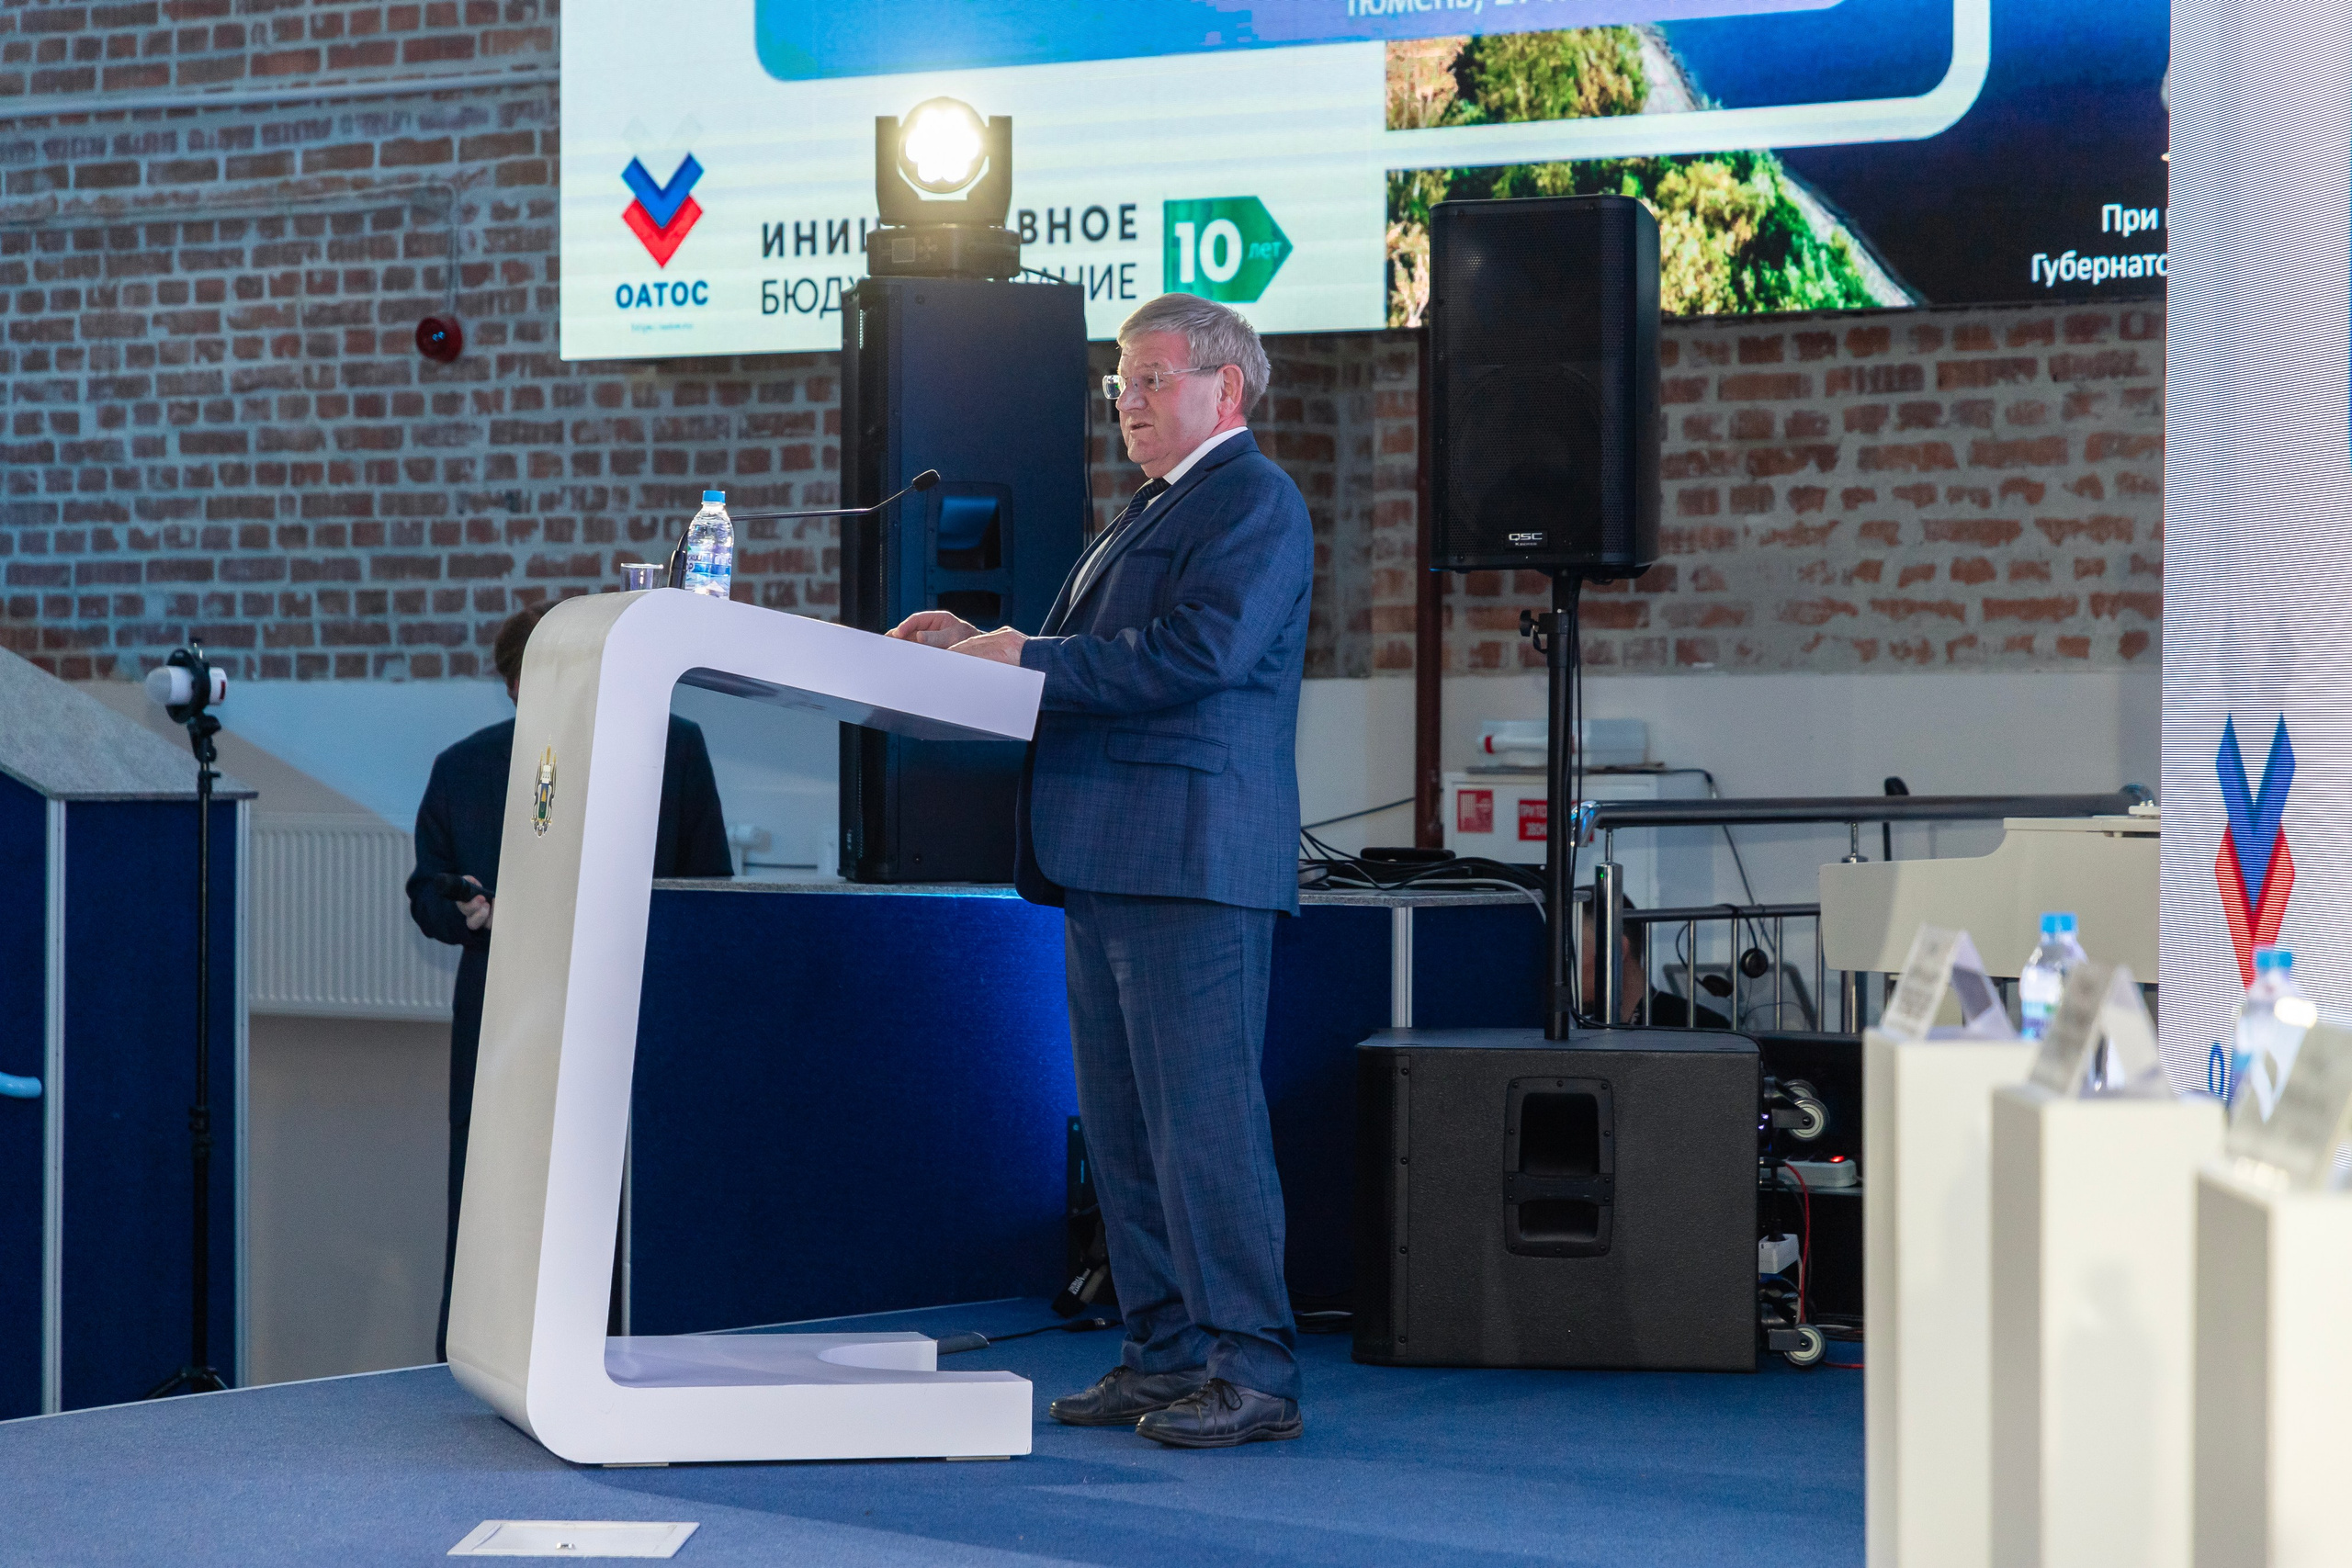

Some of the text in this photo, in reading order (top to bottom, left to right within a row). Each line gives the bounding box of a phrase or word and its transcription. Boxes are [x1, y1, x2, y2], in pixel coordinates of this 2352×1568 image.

[2102, 203, 2159, 238] При
[1174, 219, 1283, 284] 10 лет
[616, 280, 708, 309] ОАТОС
[1509, 532, 1543, 541] QSC
